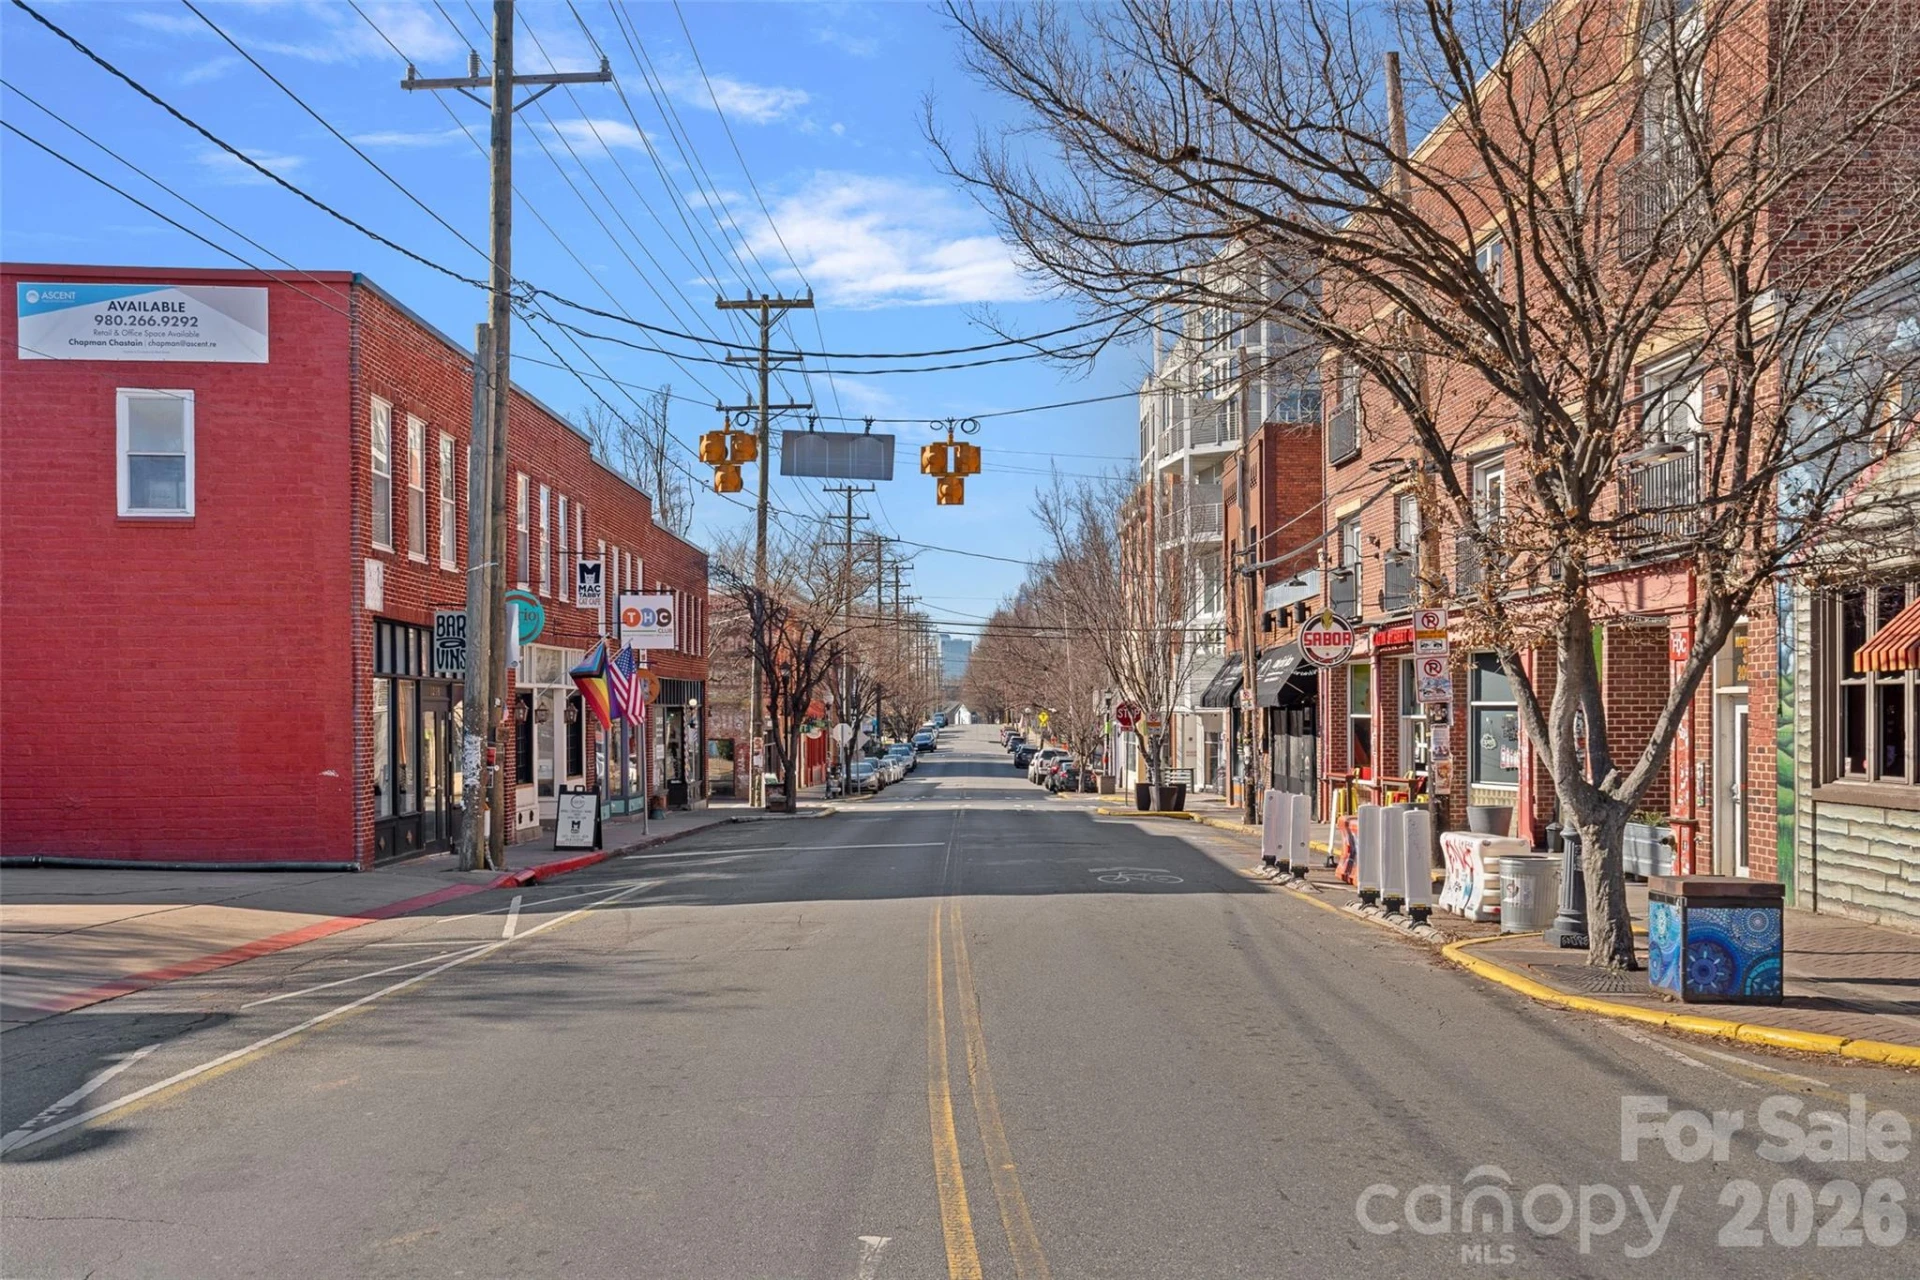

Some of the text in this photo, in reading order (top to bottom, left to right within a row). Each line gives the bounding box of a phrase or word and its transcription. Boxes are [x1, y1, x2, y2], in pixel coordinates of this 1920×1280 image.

[41, 291, 76, 300] ASCENT
[107, 300, 186, 313] AVAILABLE
[94, 314, 199, 328] 980.266.9292
[93, 329, 200, 339] Retail & Office Space Available
[68, 338, 217, 349] Chapman Chastain chapman@ascent.re
[578, 584, 601, 593] MAC
[436, 614, 467, 638] BAR
[1303, 631, 1352, 646] SABOR
[436, 648, 466, 670] VINS
[1117, 708, 1140, 719] STP
